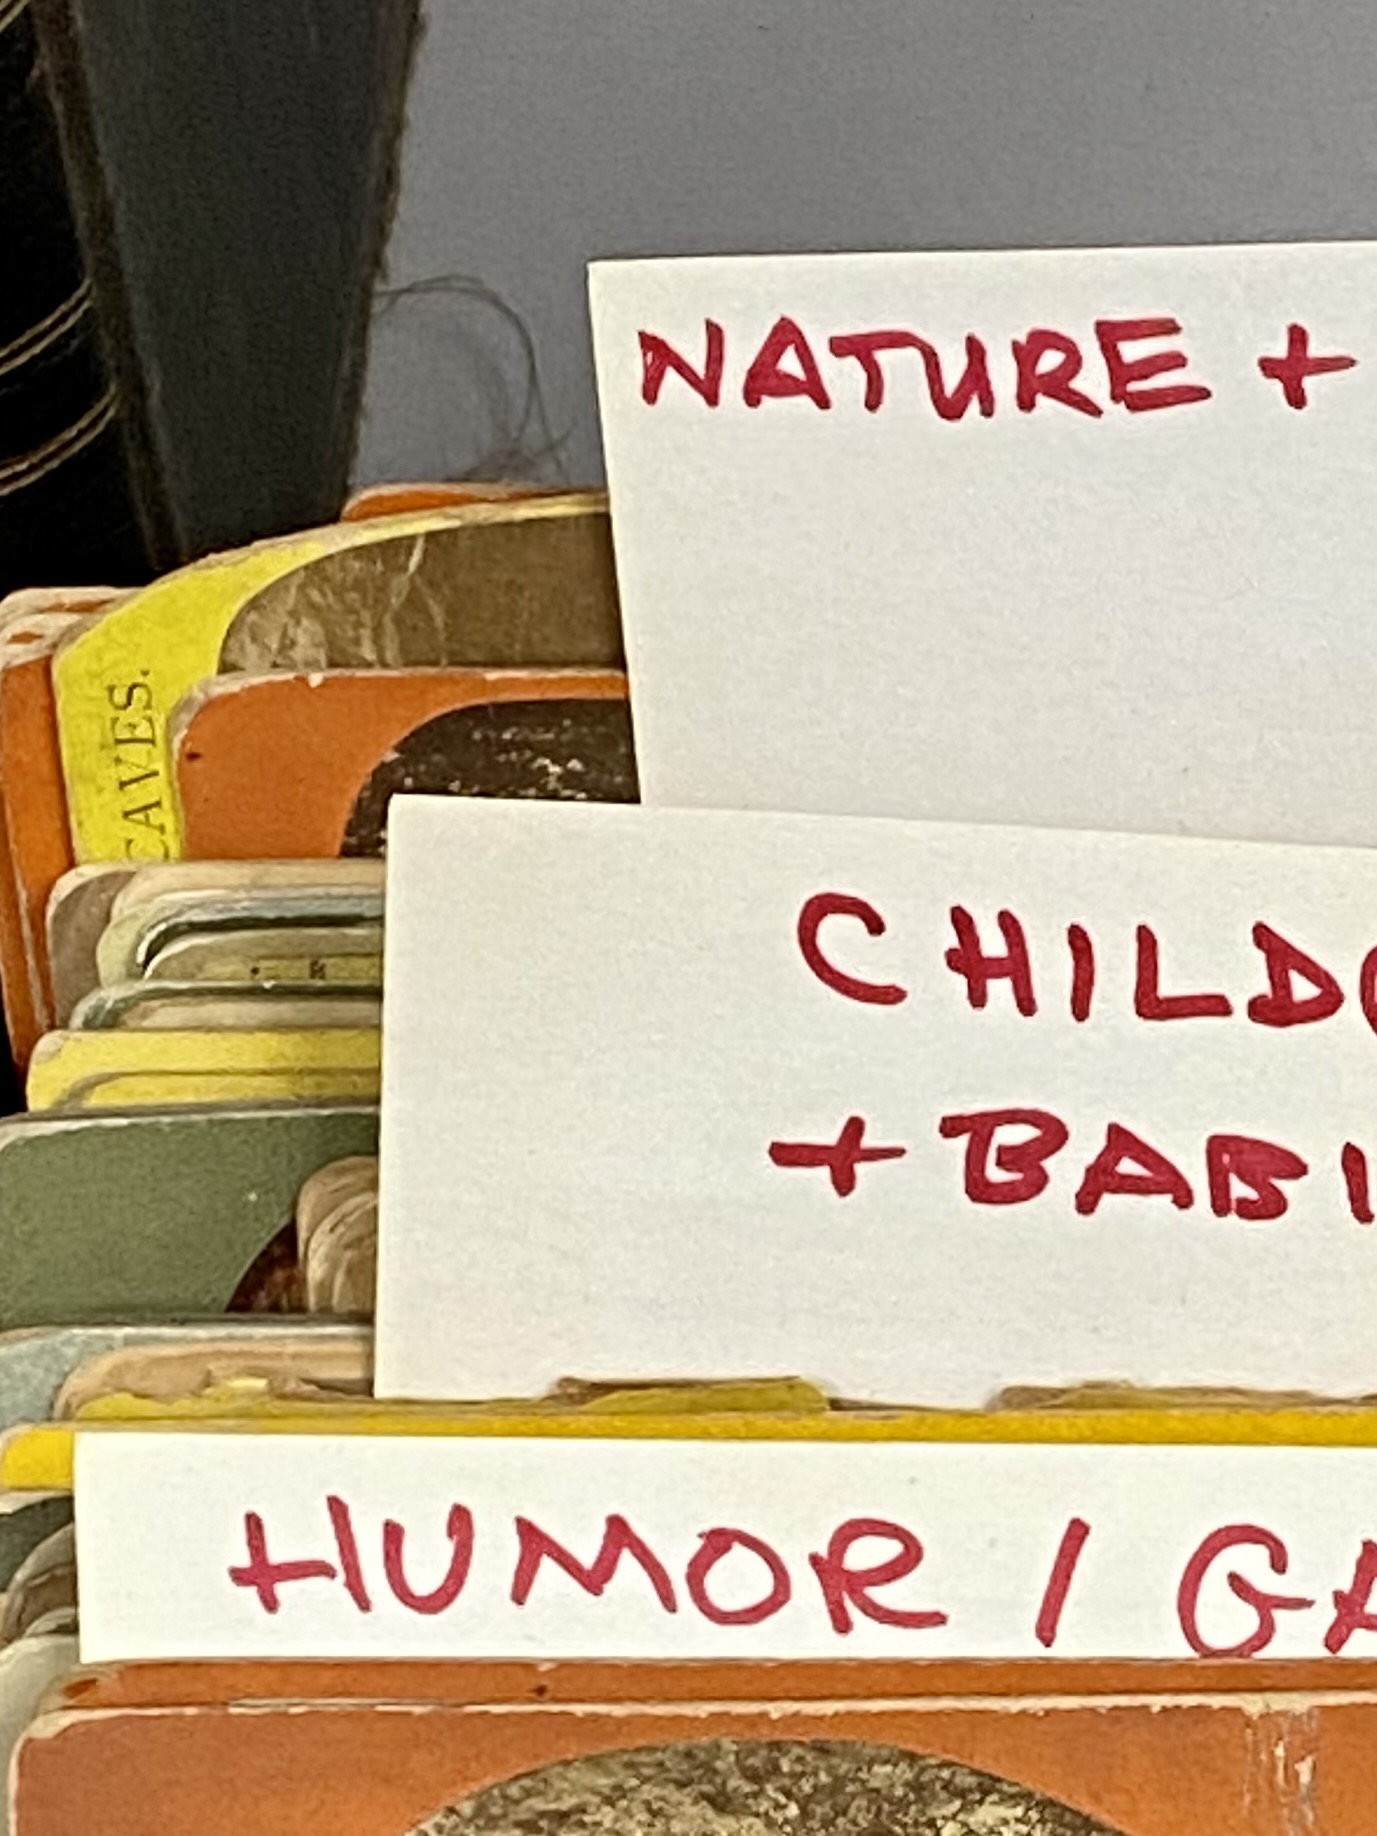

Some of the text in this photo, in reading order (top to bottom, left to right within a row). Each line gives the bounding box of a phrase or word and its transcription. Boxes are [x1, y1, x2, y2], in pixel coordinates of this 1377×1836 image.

[638, 316, 1212, 422] NATURE
[1257, 322, 1355, 410] +
[229, 1494, 949, 1635] HUMOR
